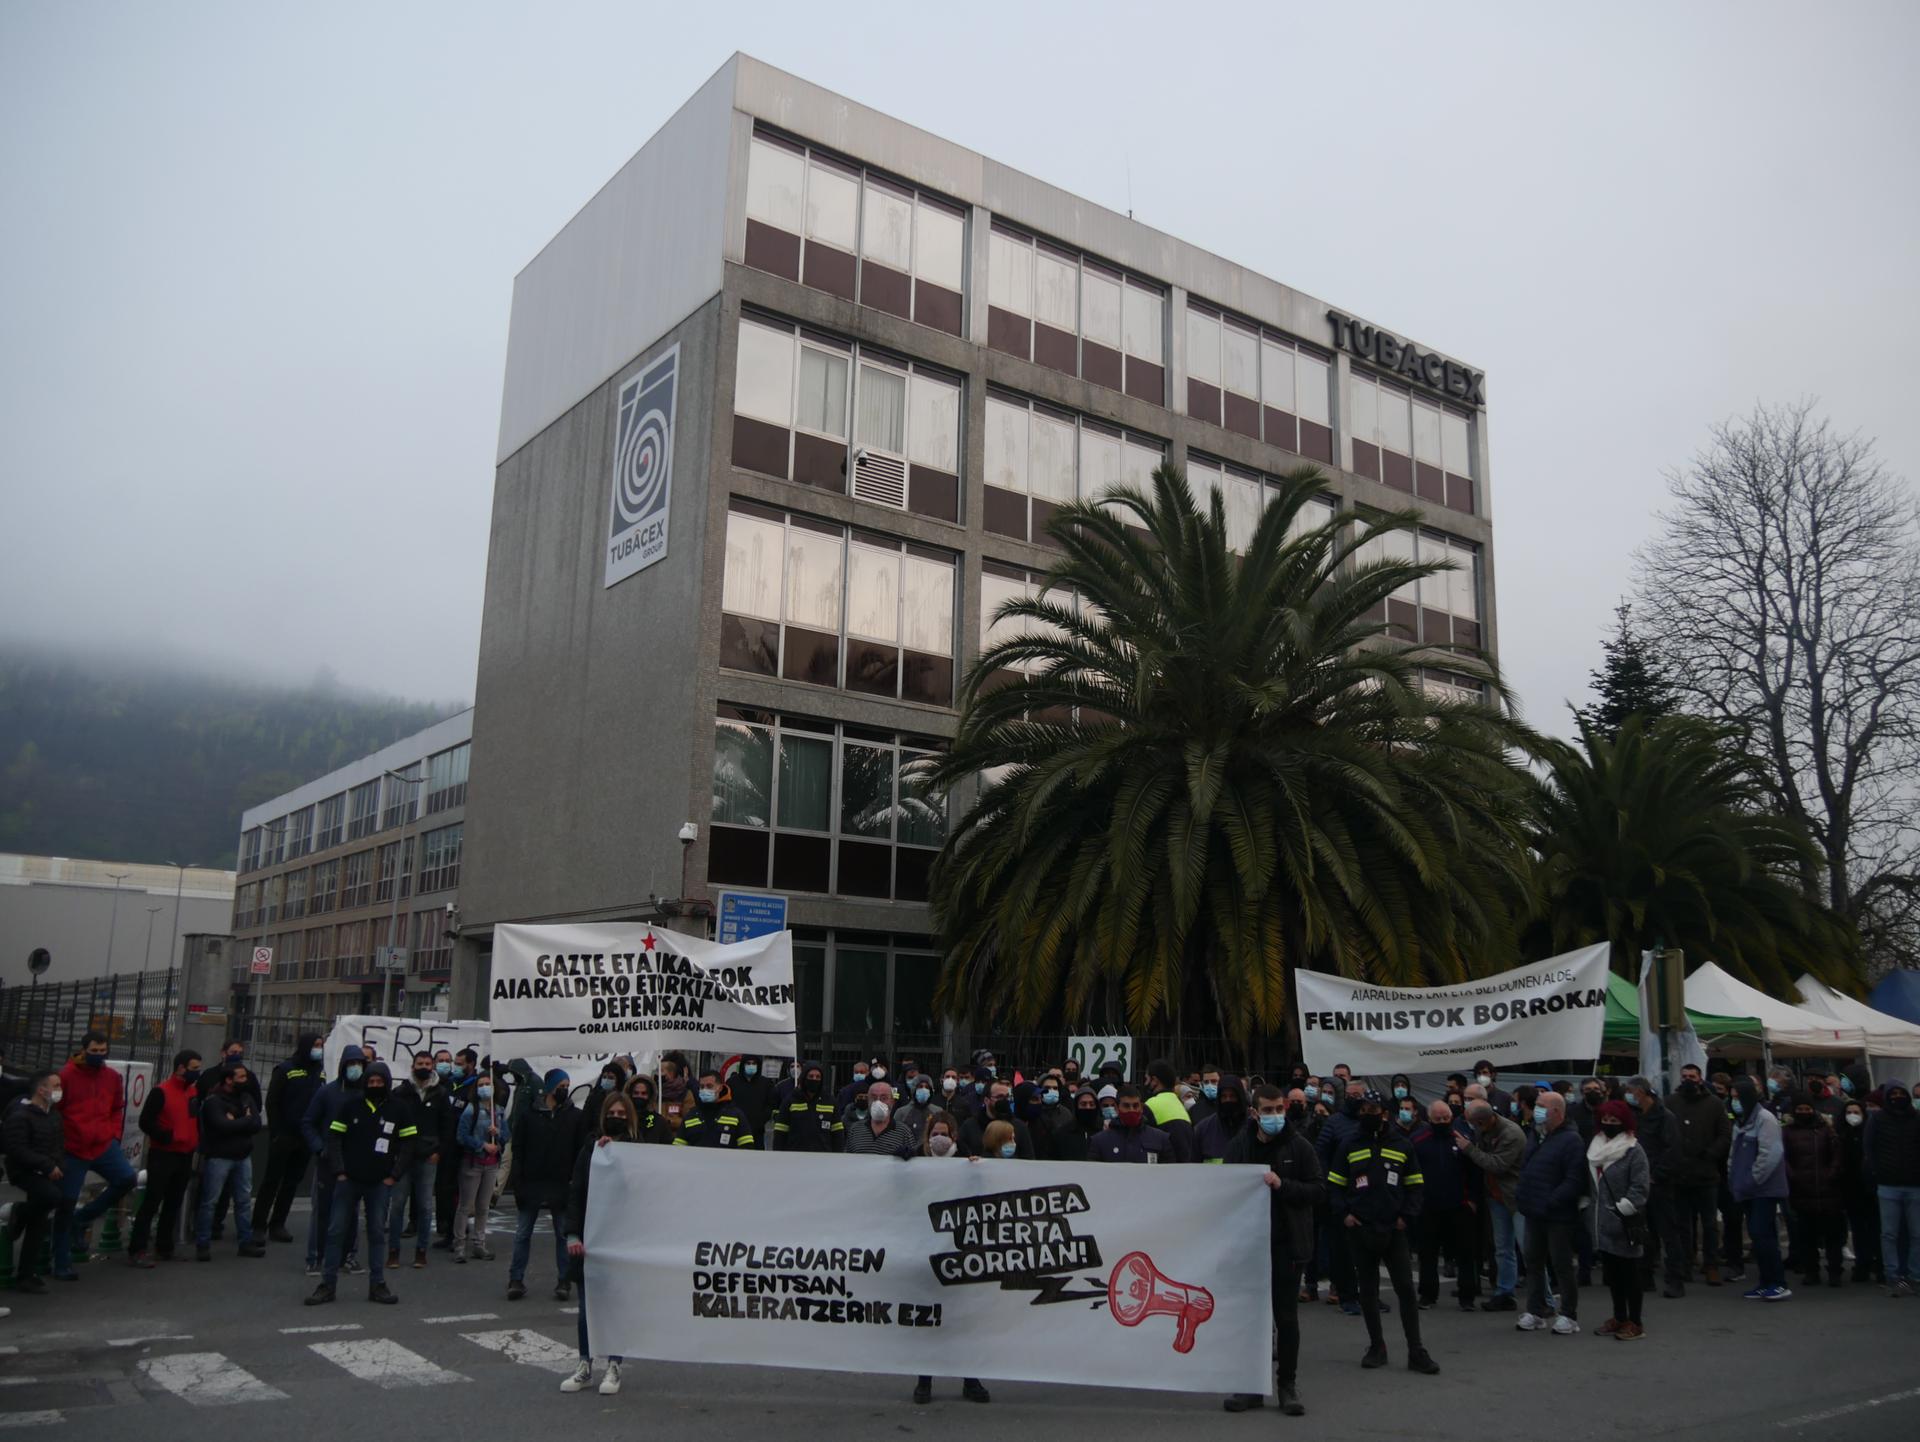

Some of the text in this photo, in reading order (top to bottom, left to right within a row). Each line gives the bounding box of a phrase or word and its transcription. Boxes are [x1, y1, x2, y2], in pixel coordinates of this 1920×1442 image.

[1326, 310, 1486, 405] TUBACEX
[642, 541, 664, 560] GROUP
[536, 952, 605, 977] GAZTE
[610, 952, 652, 974] ETA
[493, 973, 796, 1006] AIARALDEKO ETORKIZUNAREN
[1304, 986, 1608, 1032] FEMINISTOK BORROKAN
[578, 1020, 716, 1034] GORA LANGILEO BORROKA!
[938, 1191, 1086, 1231] AIARALDEA
[962, 1220, 1067, 1246] ALERTA
[694, 1241, 886, 1273] ENPLEGUAREN
[939, 1240, 1088, 1281] GORRIAN!
[692, 1271, 854, 1299] DEFENTSAN,
[692, 1291, 942, 1327] KALERATZERIK EZ!
